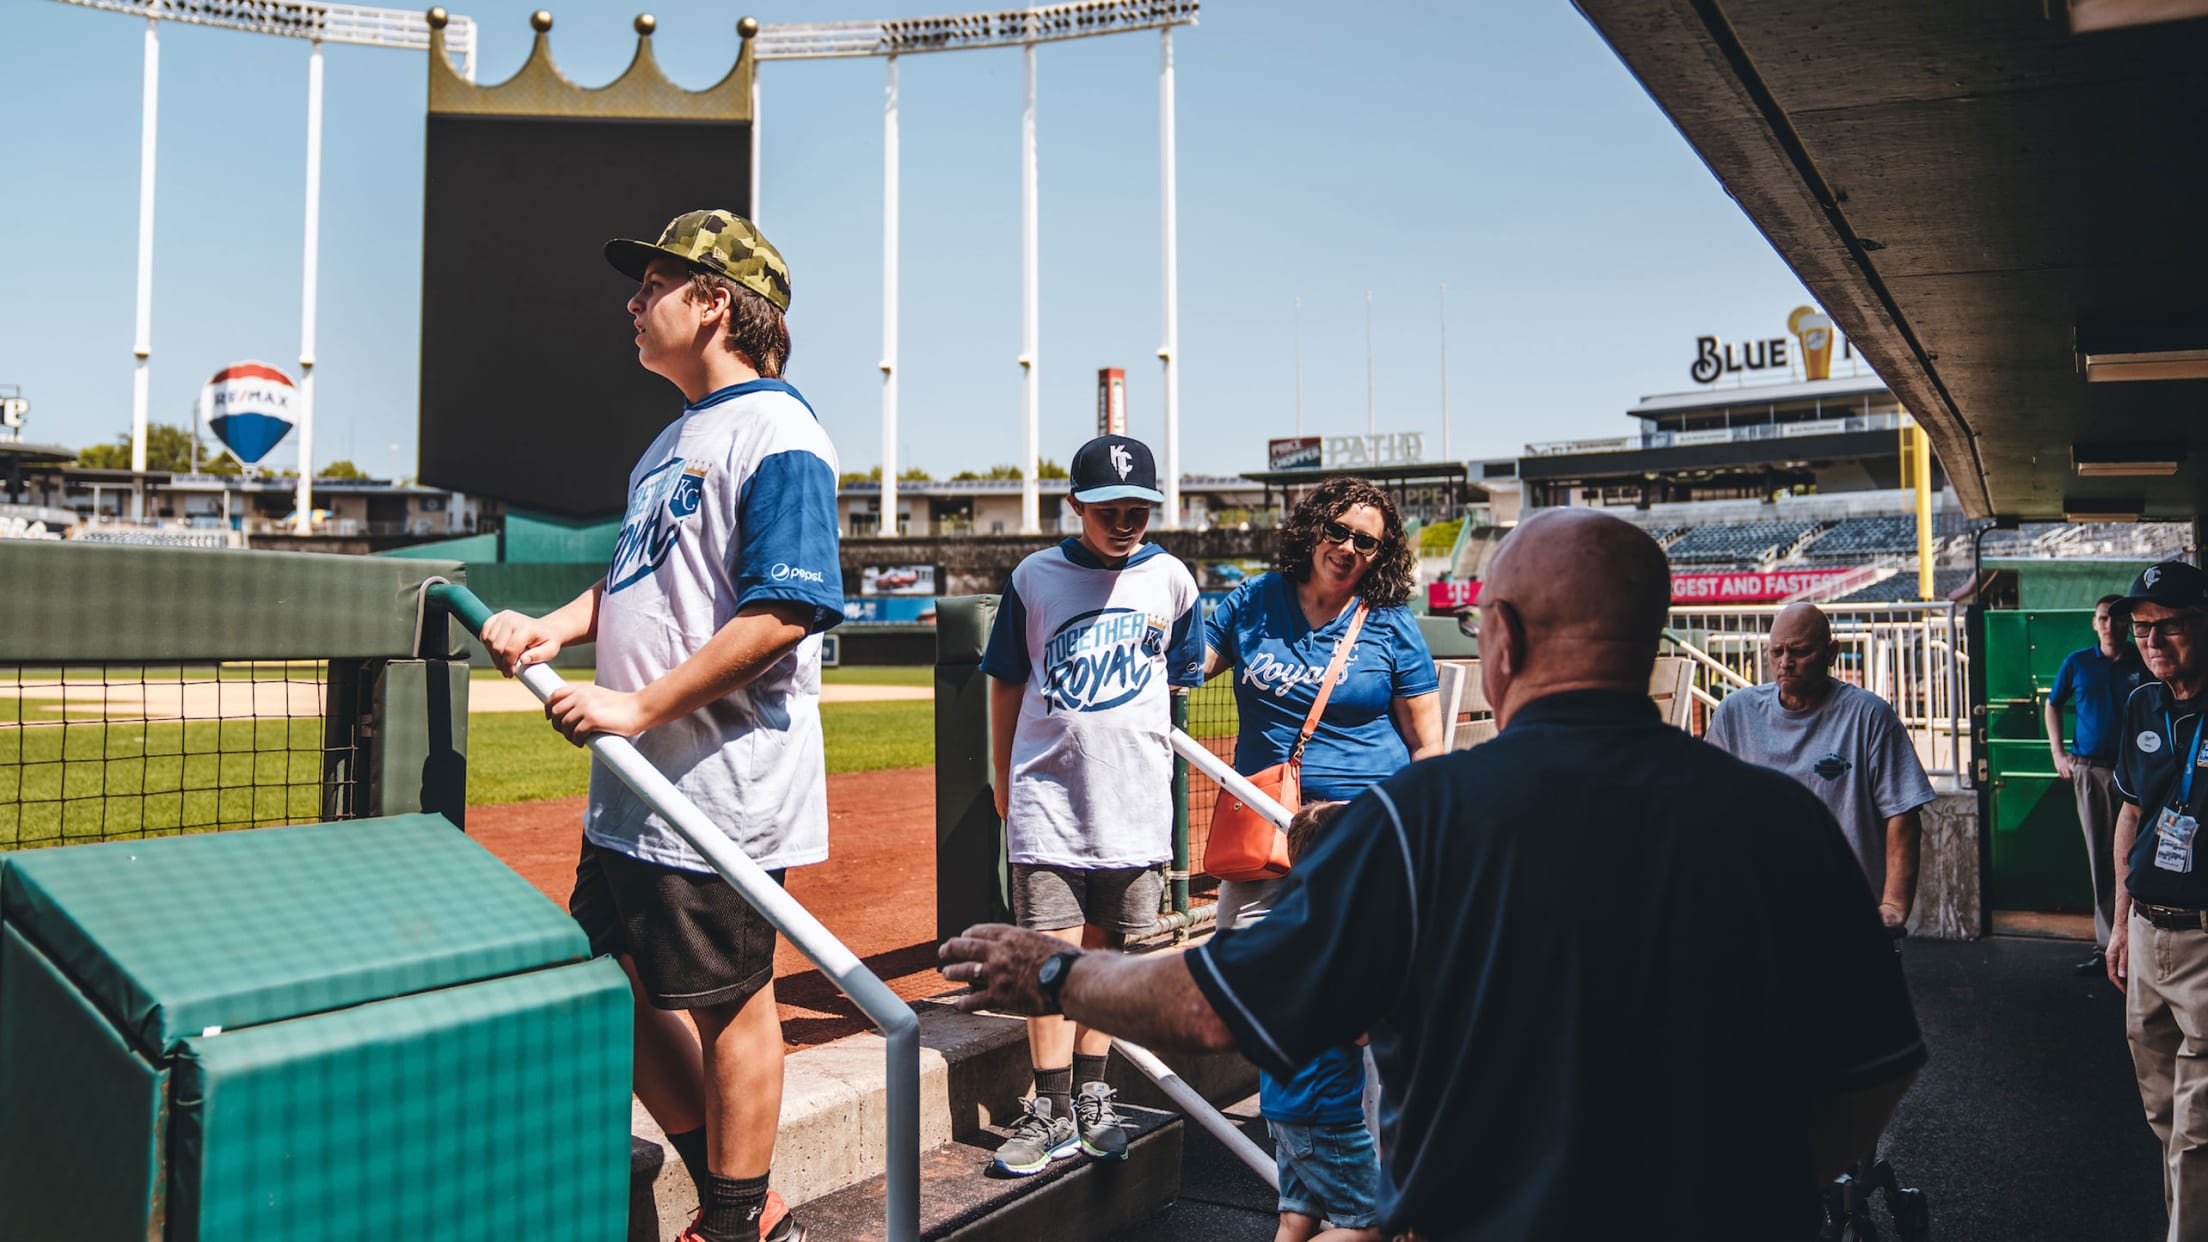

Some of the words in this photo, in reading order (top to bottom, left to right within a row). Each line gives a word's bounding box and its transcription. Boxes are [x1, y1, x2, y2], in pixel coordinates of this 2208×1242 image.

[214, 389, 287, 407] RE/MAX
[1109, 444, 1133, 482] KC
[1326, 432, 1424, 466] PATIO
[672, 478, 700, 511] KC
[1671, 577, 1719, 597] GEST
[1720, 575, 1762, 596] AND
[1045, 612, 1146, 668] TOGETHER
[1043, 642, 1154, 716] ROYAL
